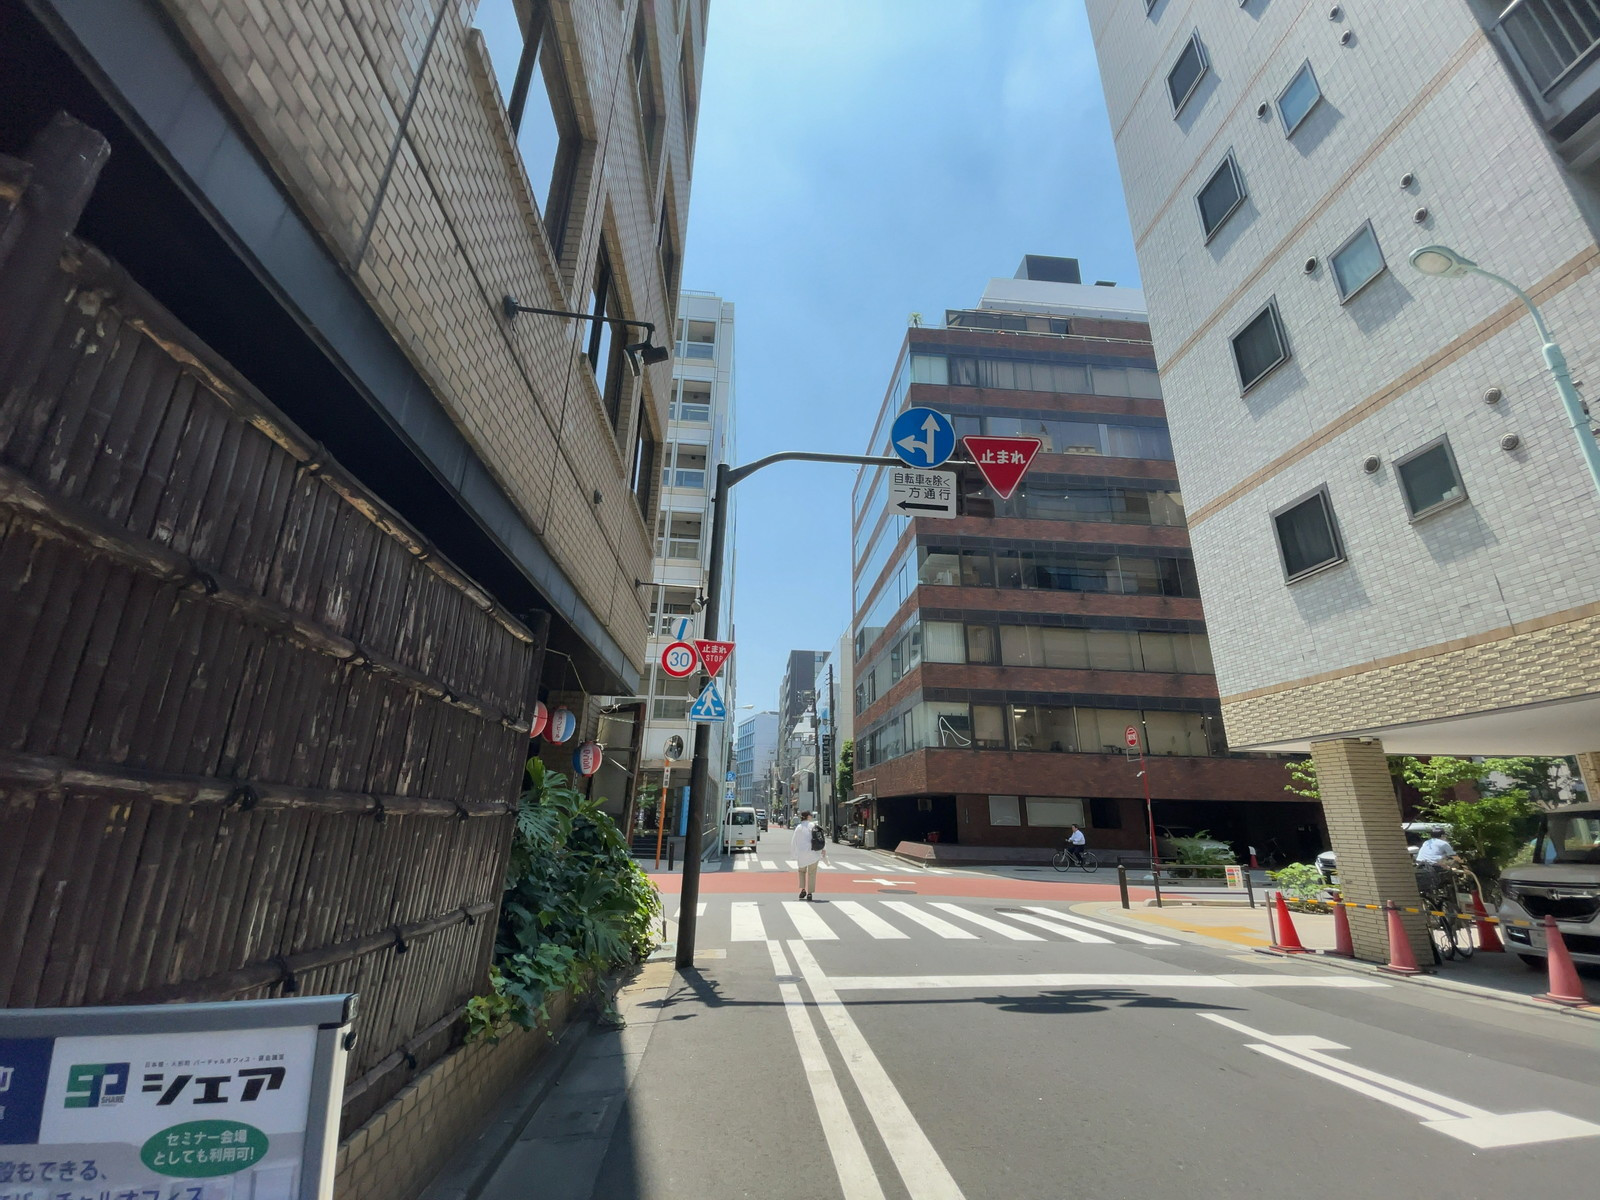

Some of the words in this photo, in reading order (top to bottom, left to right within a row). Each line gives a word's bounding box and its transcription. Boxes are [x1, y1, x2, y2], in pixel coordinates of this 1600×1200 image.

[979, 449, 1026, 465] 止まれ
[894, 472, 950, 487] 自転車を除く
[894, 487, 951, 501] 一方通行
[702, 644, 727, 654] 止まれ
[669, 651, 690, 668] 30
[705, 654, 723, 662] STOP
[142, 1066, 286, 1106] シェア
[166, 1129, 247, 1146] セミナー会場
